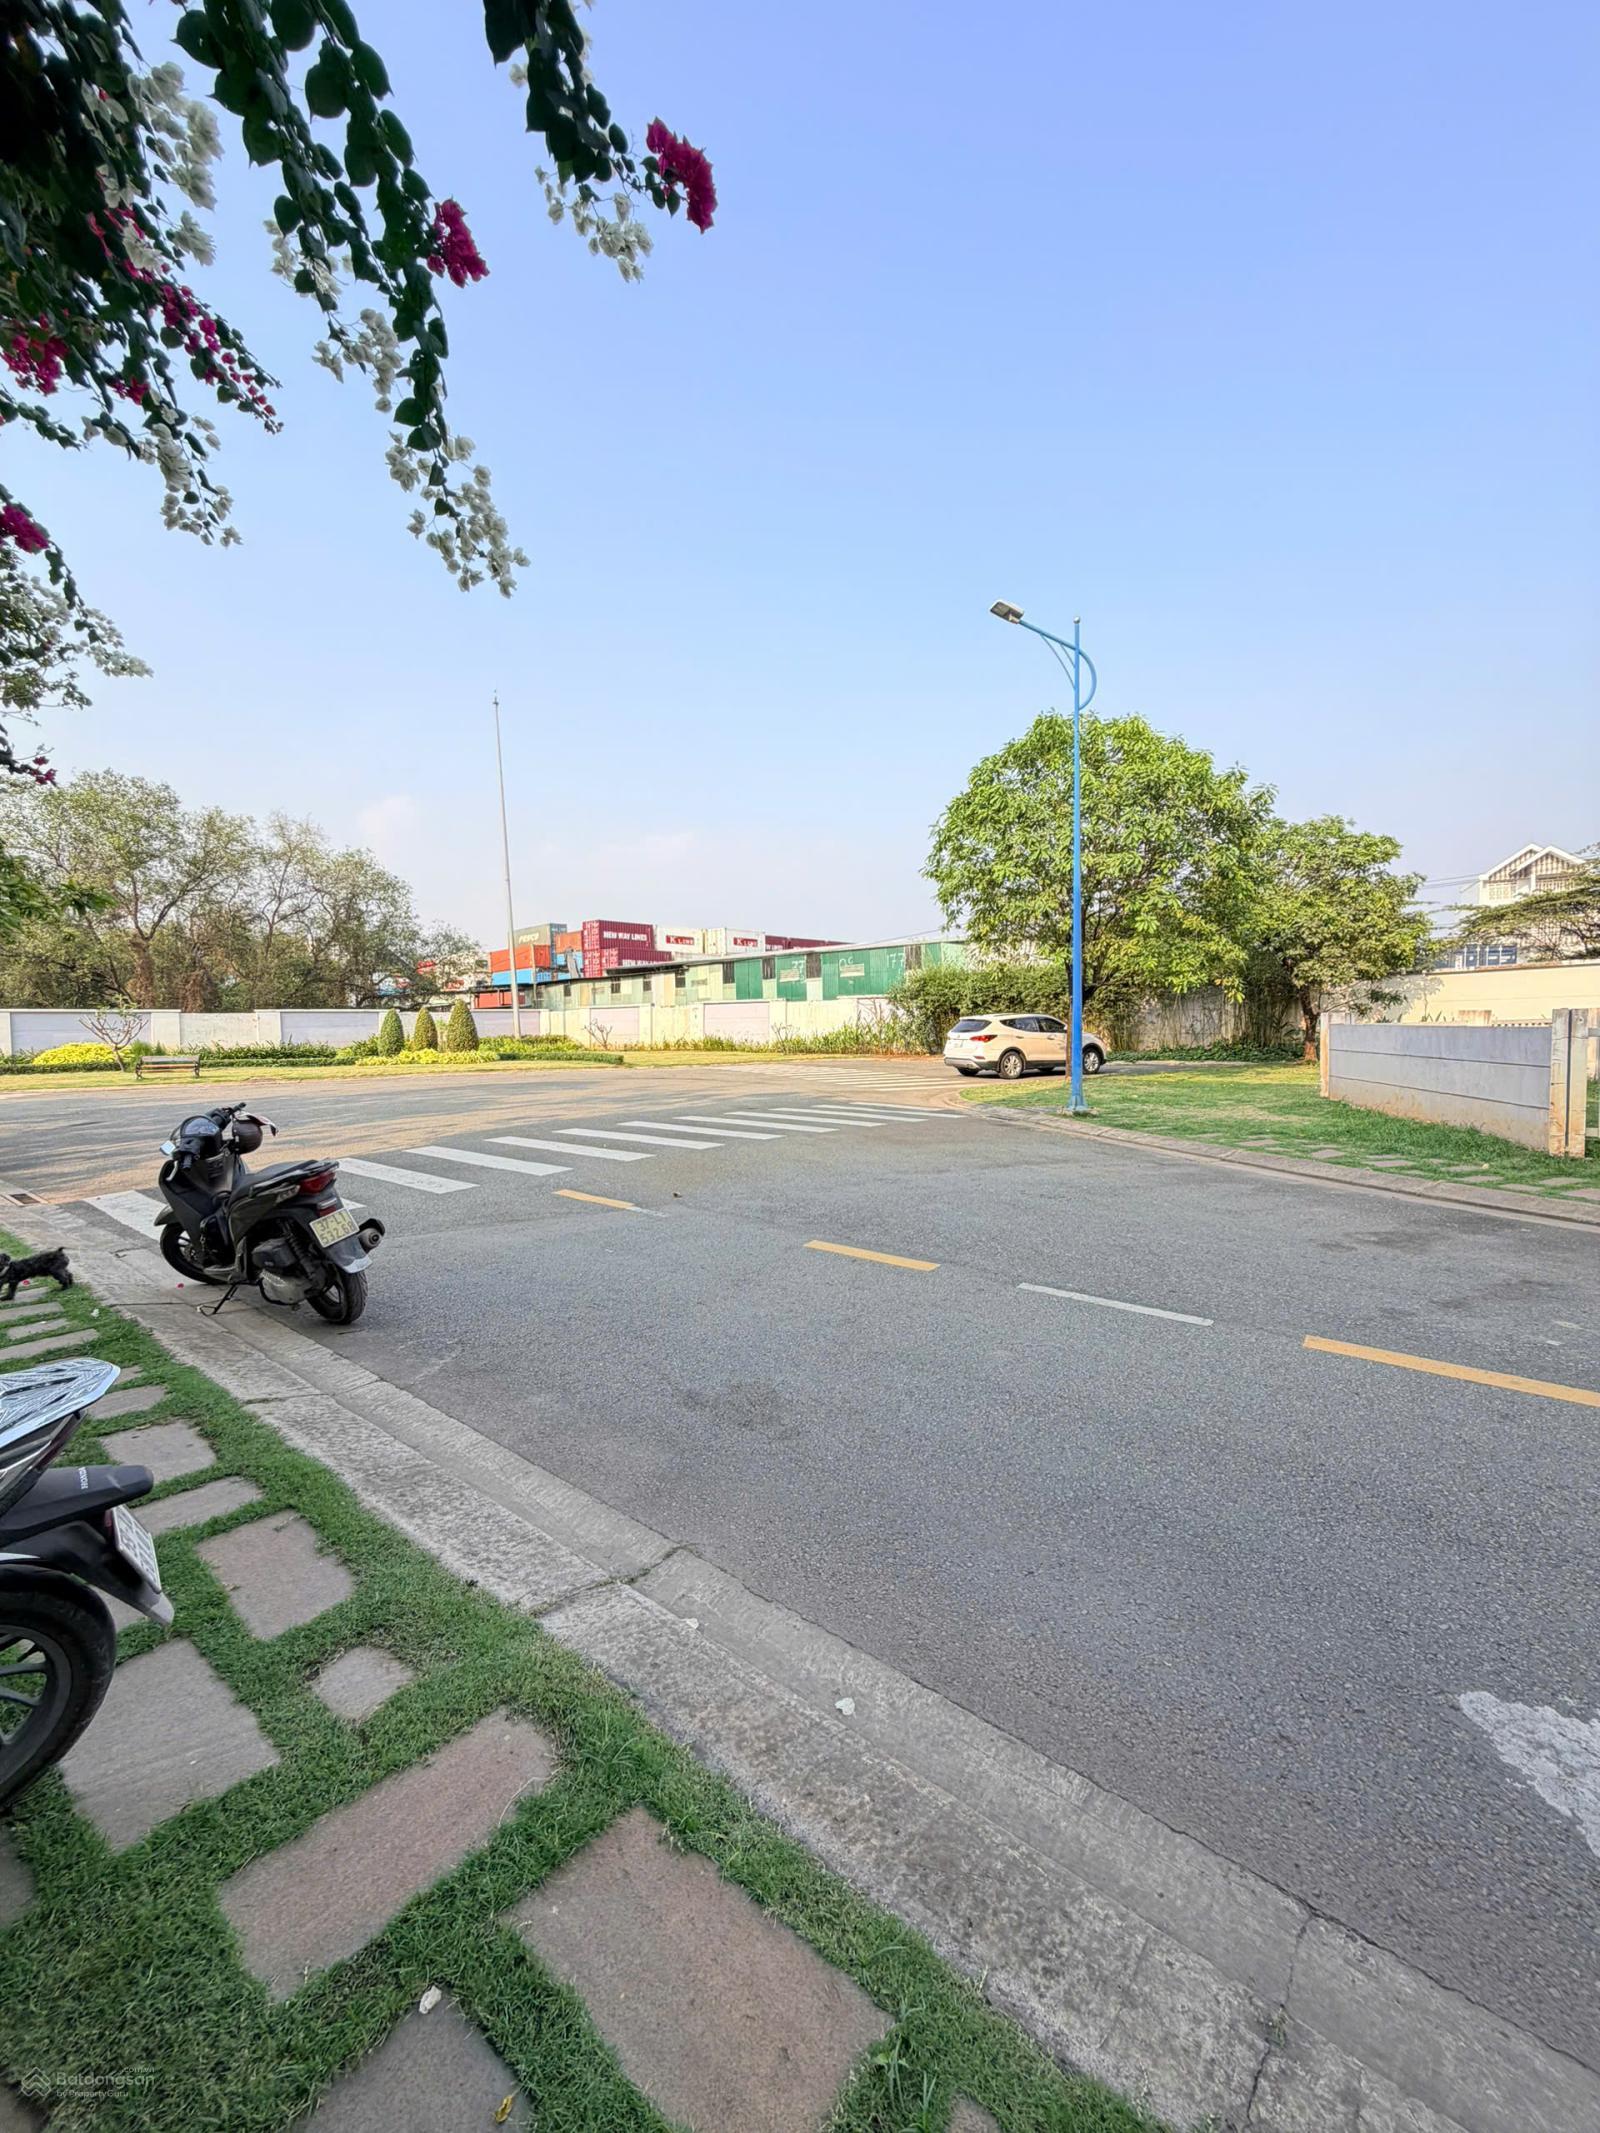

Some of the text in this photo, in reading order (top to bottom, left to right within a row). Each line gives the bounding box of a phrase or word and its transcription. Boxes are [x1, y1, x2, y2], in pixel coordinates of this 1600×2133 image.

[618, 932, 630, 940] WAY
[631, 933, 648, 941] LINES
[79, 1467, 89, 1489] HONDA
